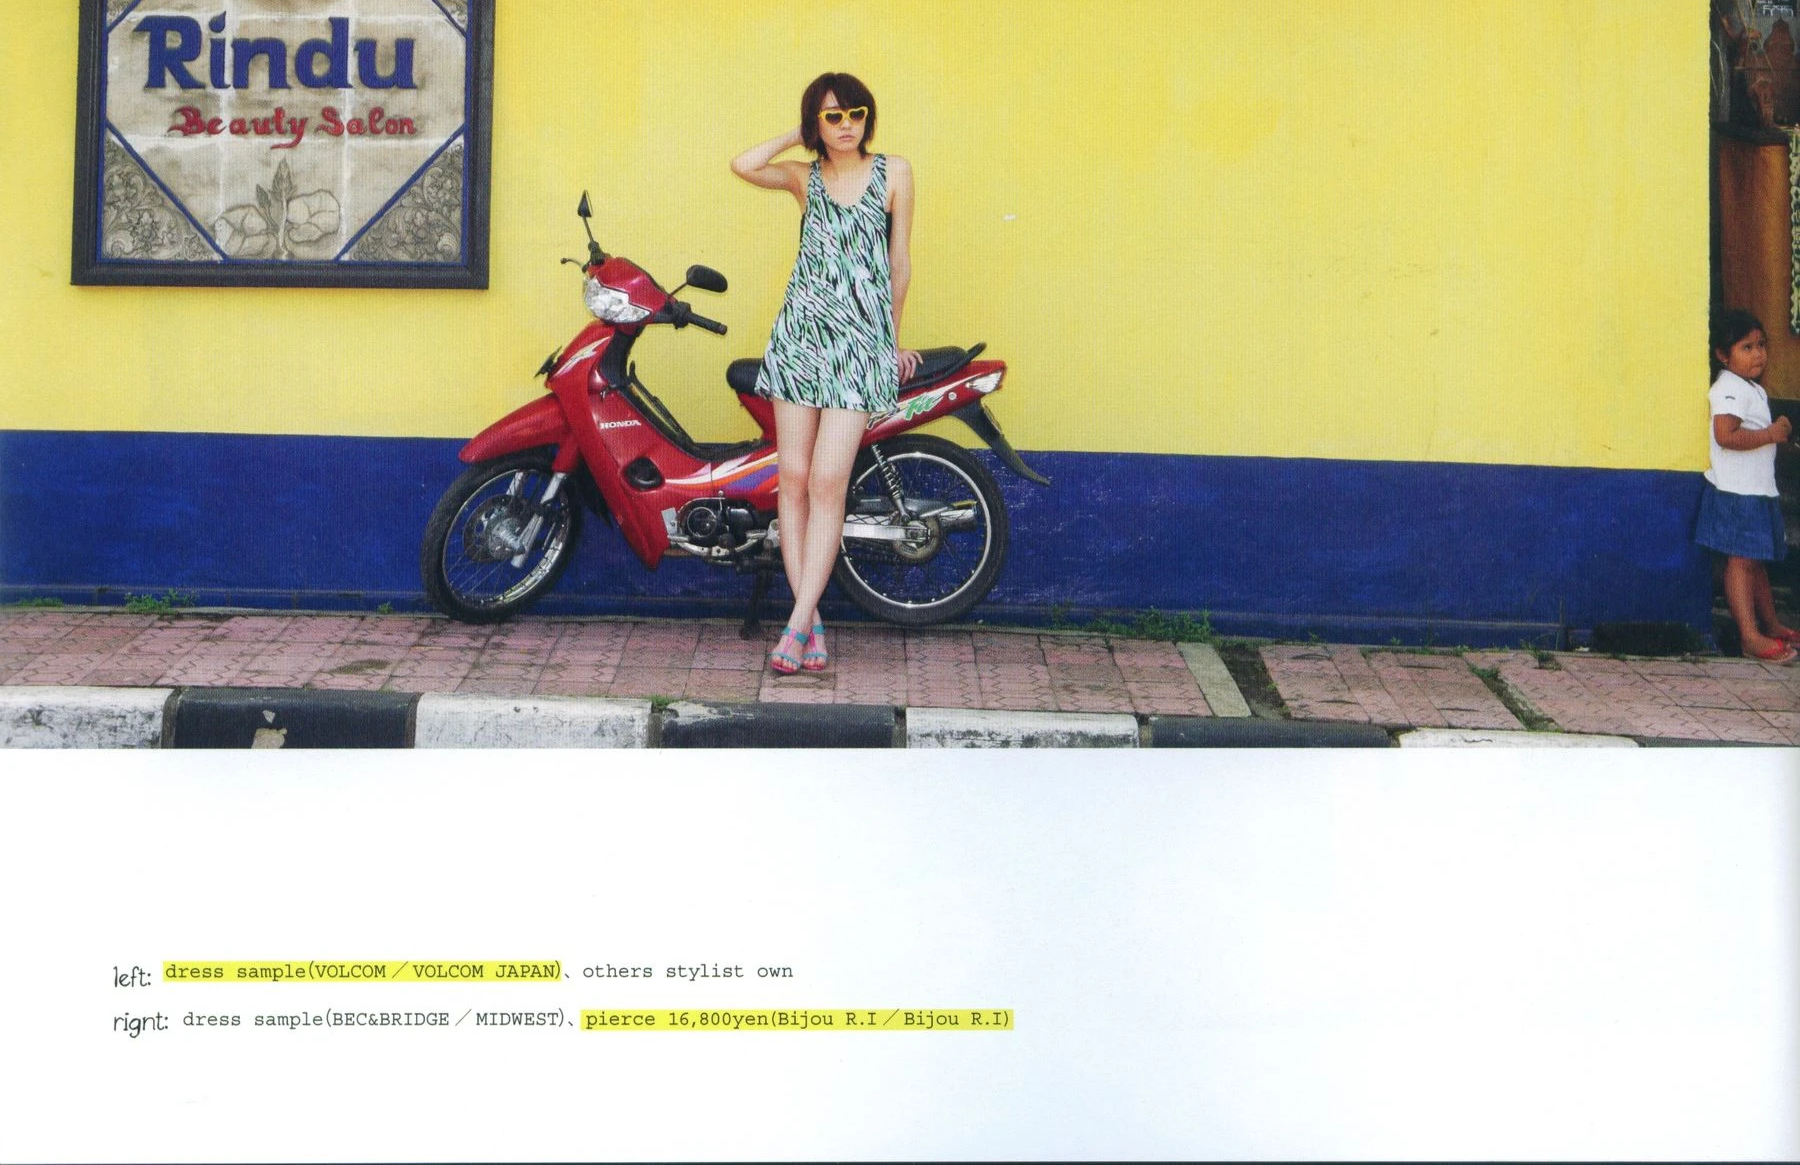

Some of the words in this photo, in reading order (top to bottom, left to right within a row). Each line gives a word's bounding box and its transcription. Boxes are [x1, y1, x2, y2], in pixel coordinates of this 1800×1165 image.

[133, 11, 417, 90] Rindu
[169, 106, 309, 149] Beauty
[318, 106, 417, 135] Salon
[599, 419, 642, 430] HONDA
